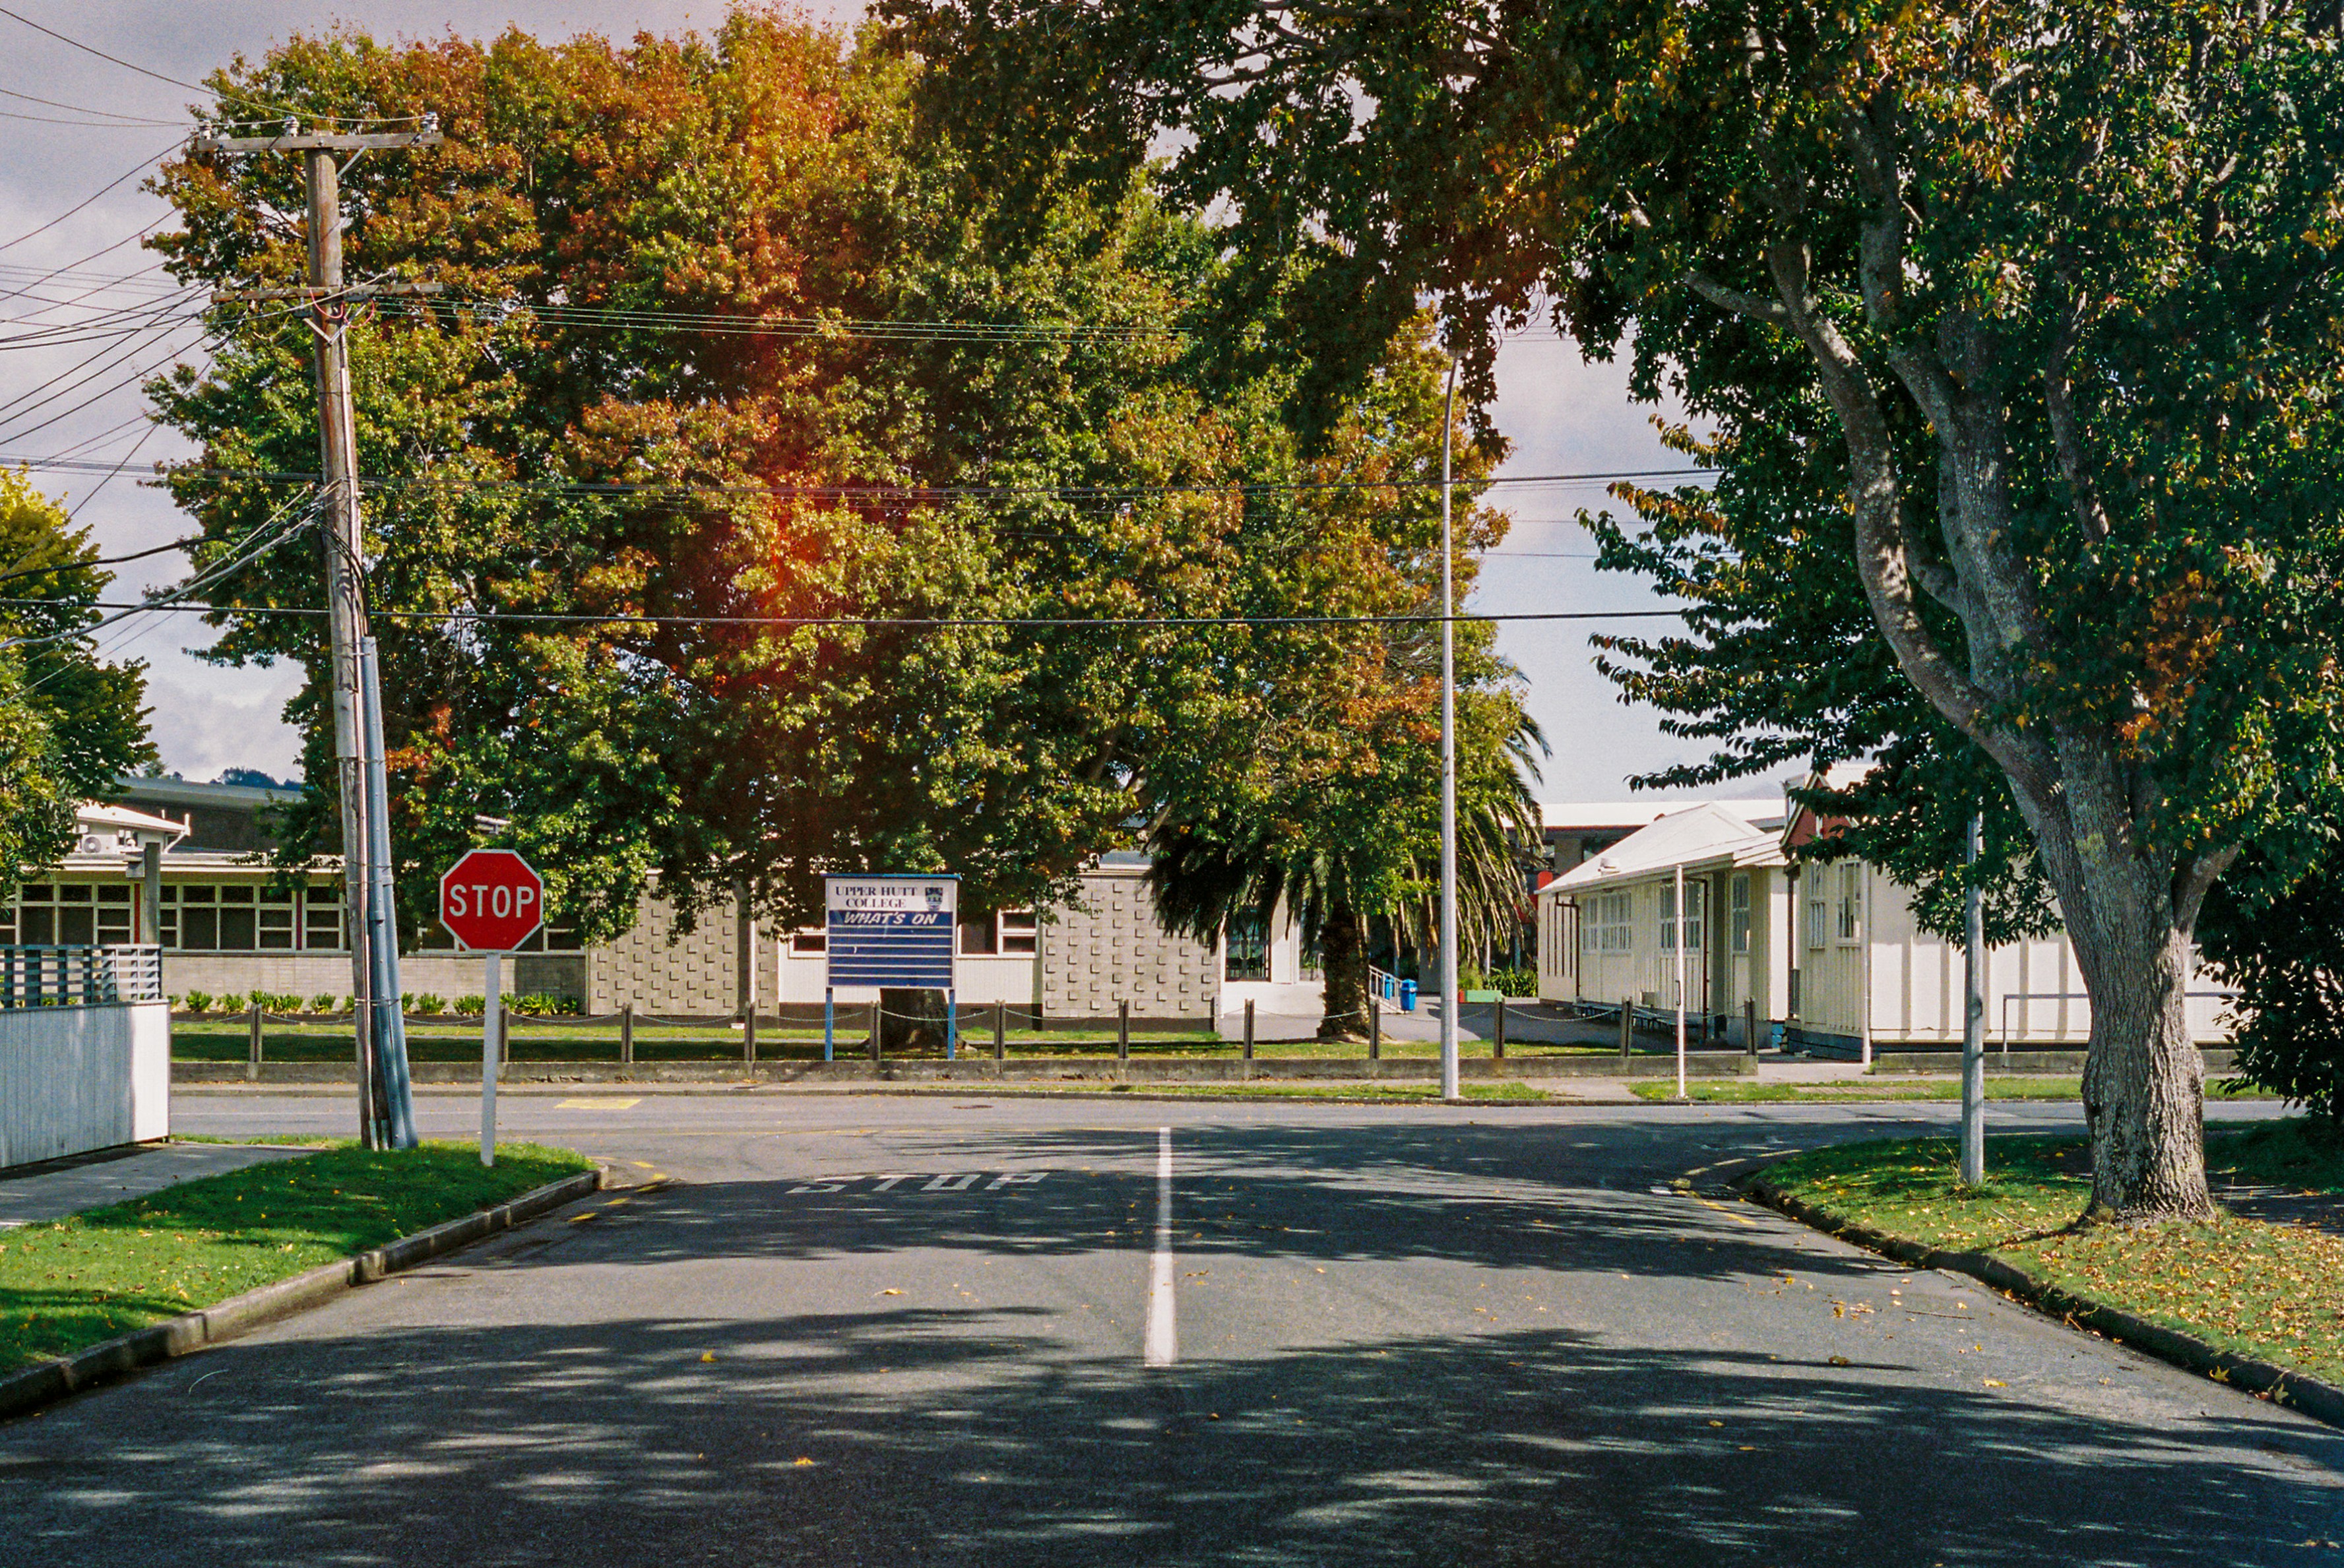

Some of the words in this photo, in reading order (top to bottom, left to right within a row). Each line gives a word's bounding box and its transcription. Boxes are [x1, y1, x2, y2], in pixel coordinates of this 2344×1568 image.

[835, 886, 876, 896] UPPER
[881, 887, 918, 896] HUTT
[449, 884, 534, 918] STOP
[845, 898, 906, 908] COLLEGE
[844, 912, 906, 924] WHAT'S
[912, 913, 937, 924] ON
[784, 1172, 1050, 1194] STOP
